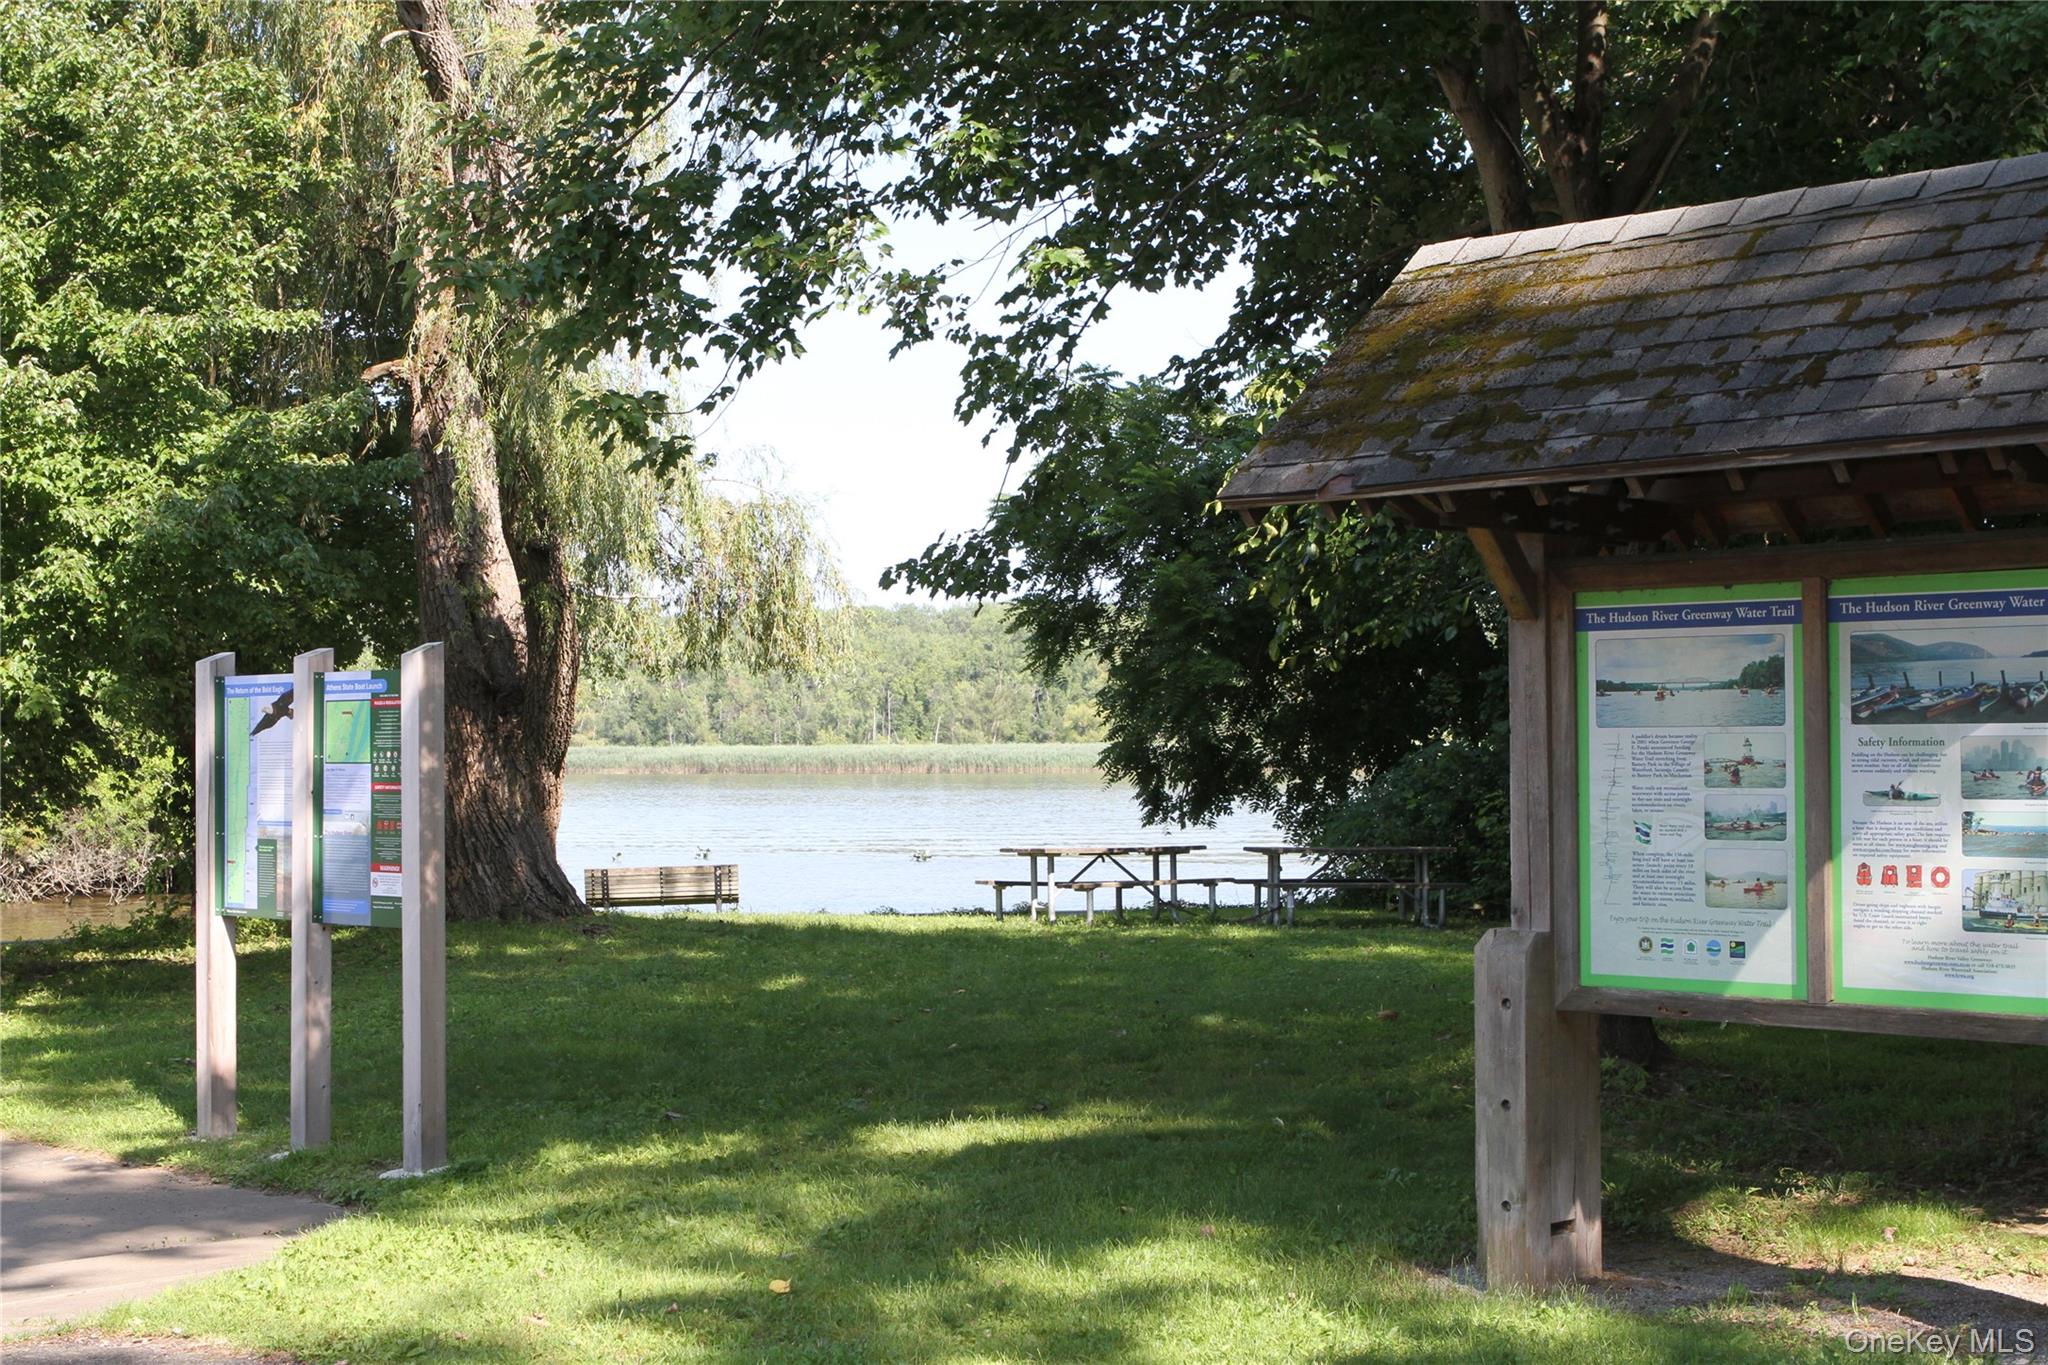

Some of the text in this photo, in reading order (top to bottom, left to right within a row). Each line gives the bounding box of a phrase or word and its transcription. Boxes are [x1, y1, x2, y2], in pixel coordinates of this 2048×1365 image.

[1586, 605, 1795, 624] The Hudson River Greenway Water Trail
[1840, 595, 2045, 615] The Hudson River Greenway Water
[1858, 736, 1945, 749] Safety Information
